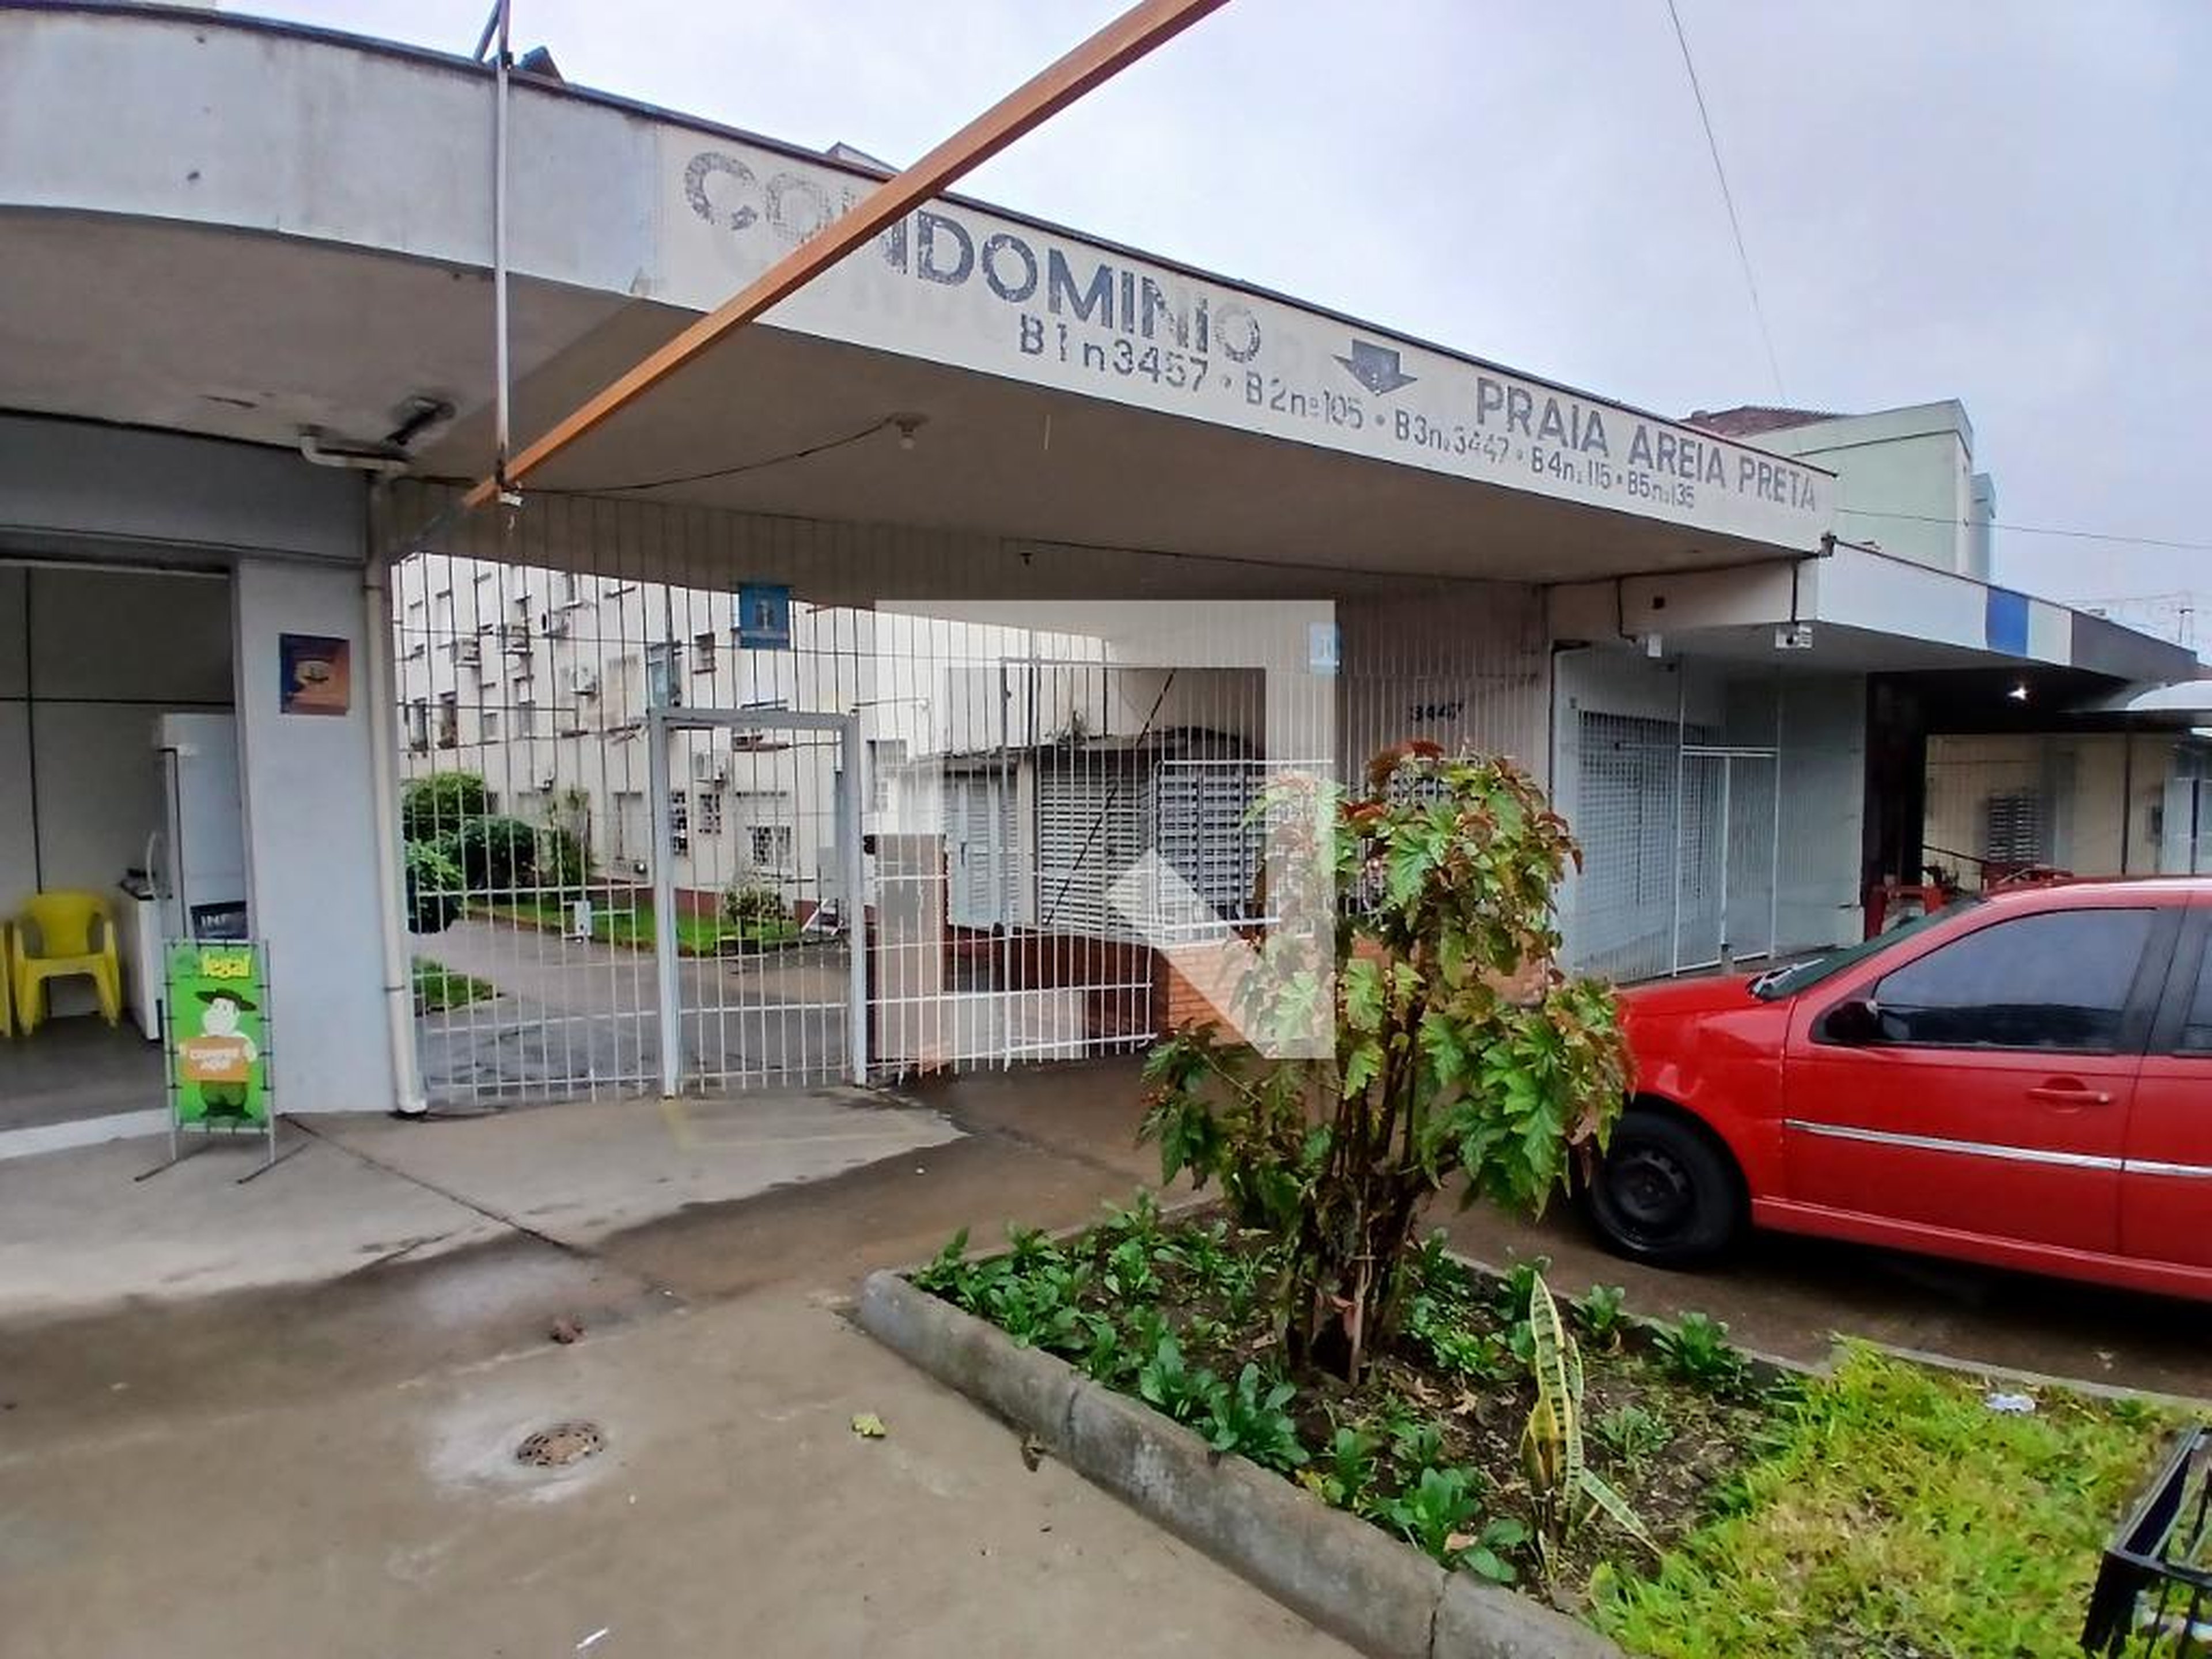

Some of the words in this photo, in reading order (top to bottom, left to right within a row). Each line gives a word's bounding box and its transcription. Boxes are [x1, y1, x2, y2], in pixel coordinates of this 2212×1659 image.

[1476, 376, 1609, 458] PRAIA
[1628, 424, 1726, 488] AREIA
[1738, 455, 1816, 512] PRETA
